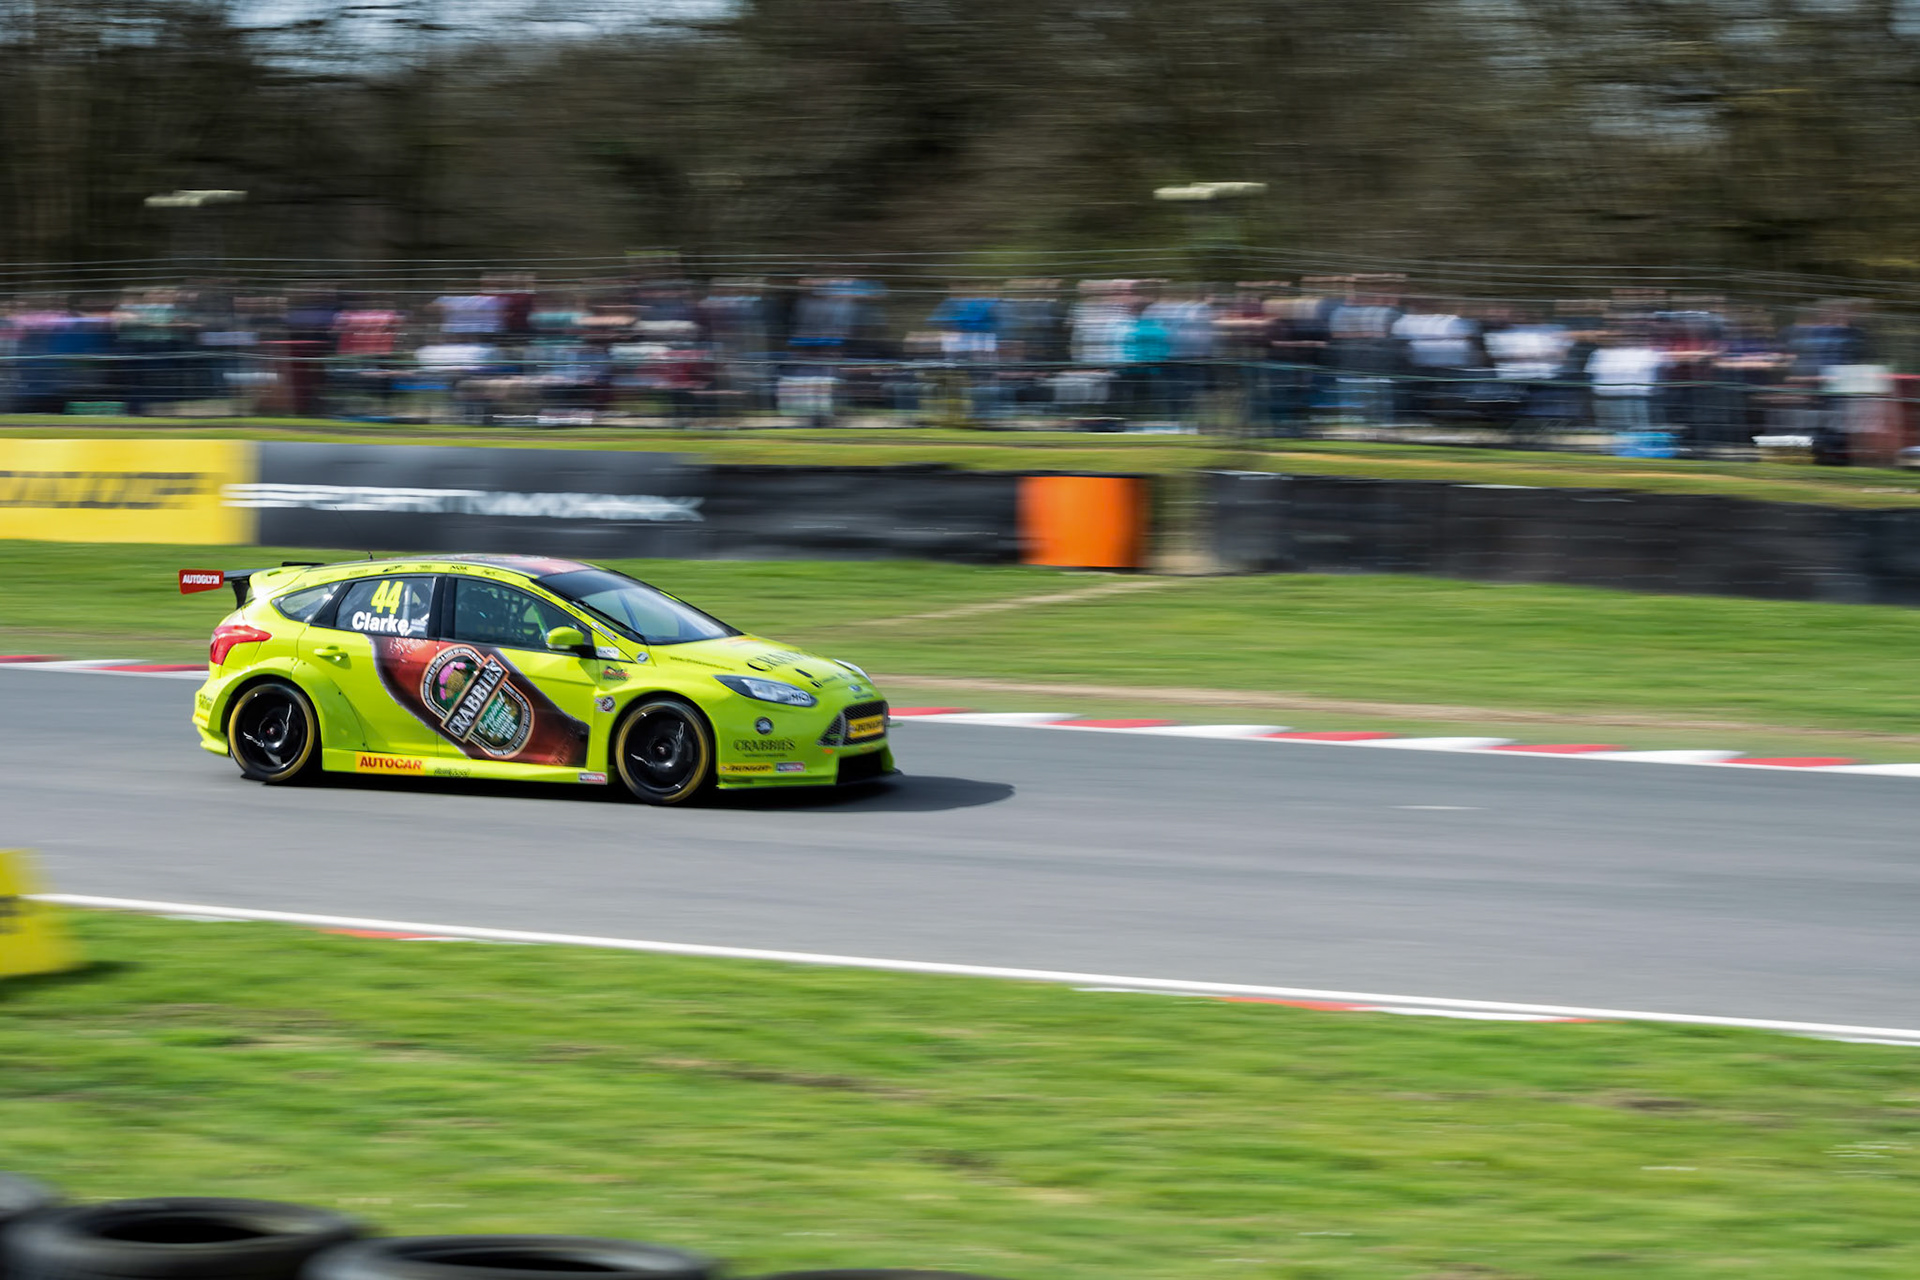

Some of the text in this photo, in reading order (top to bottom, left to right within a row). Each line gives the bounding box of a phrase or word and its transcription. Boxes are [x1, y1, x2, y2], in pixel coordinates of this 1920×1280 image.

[182, 573, 220, 586] AUTOGLYM
[371, 580, 404, 614] 44
[351, 611, 410, 636] Clarke
[360, 755, 422, 770] AUTOCAR
